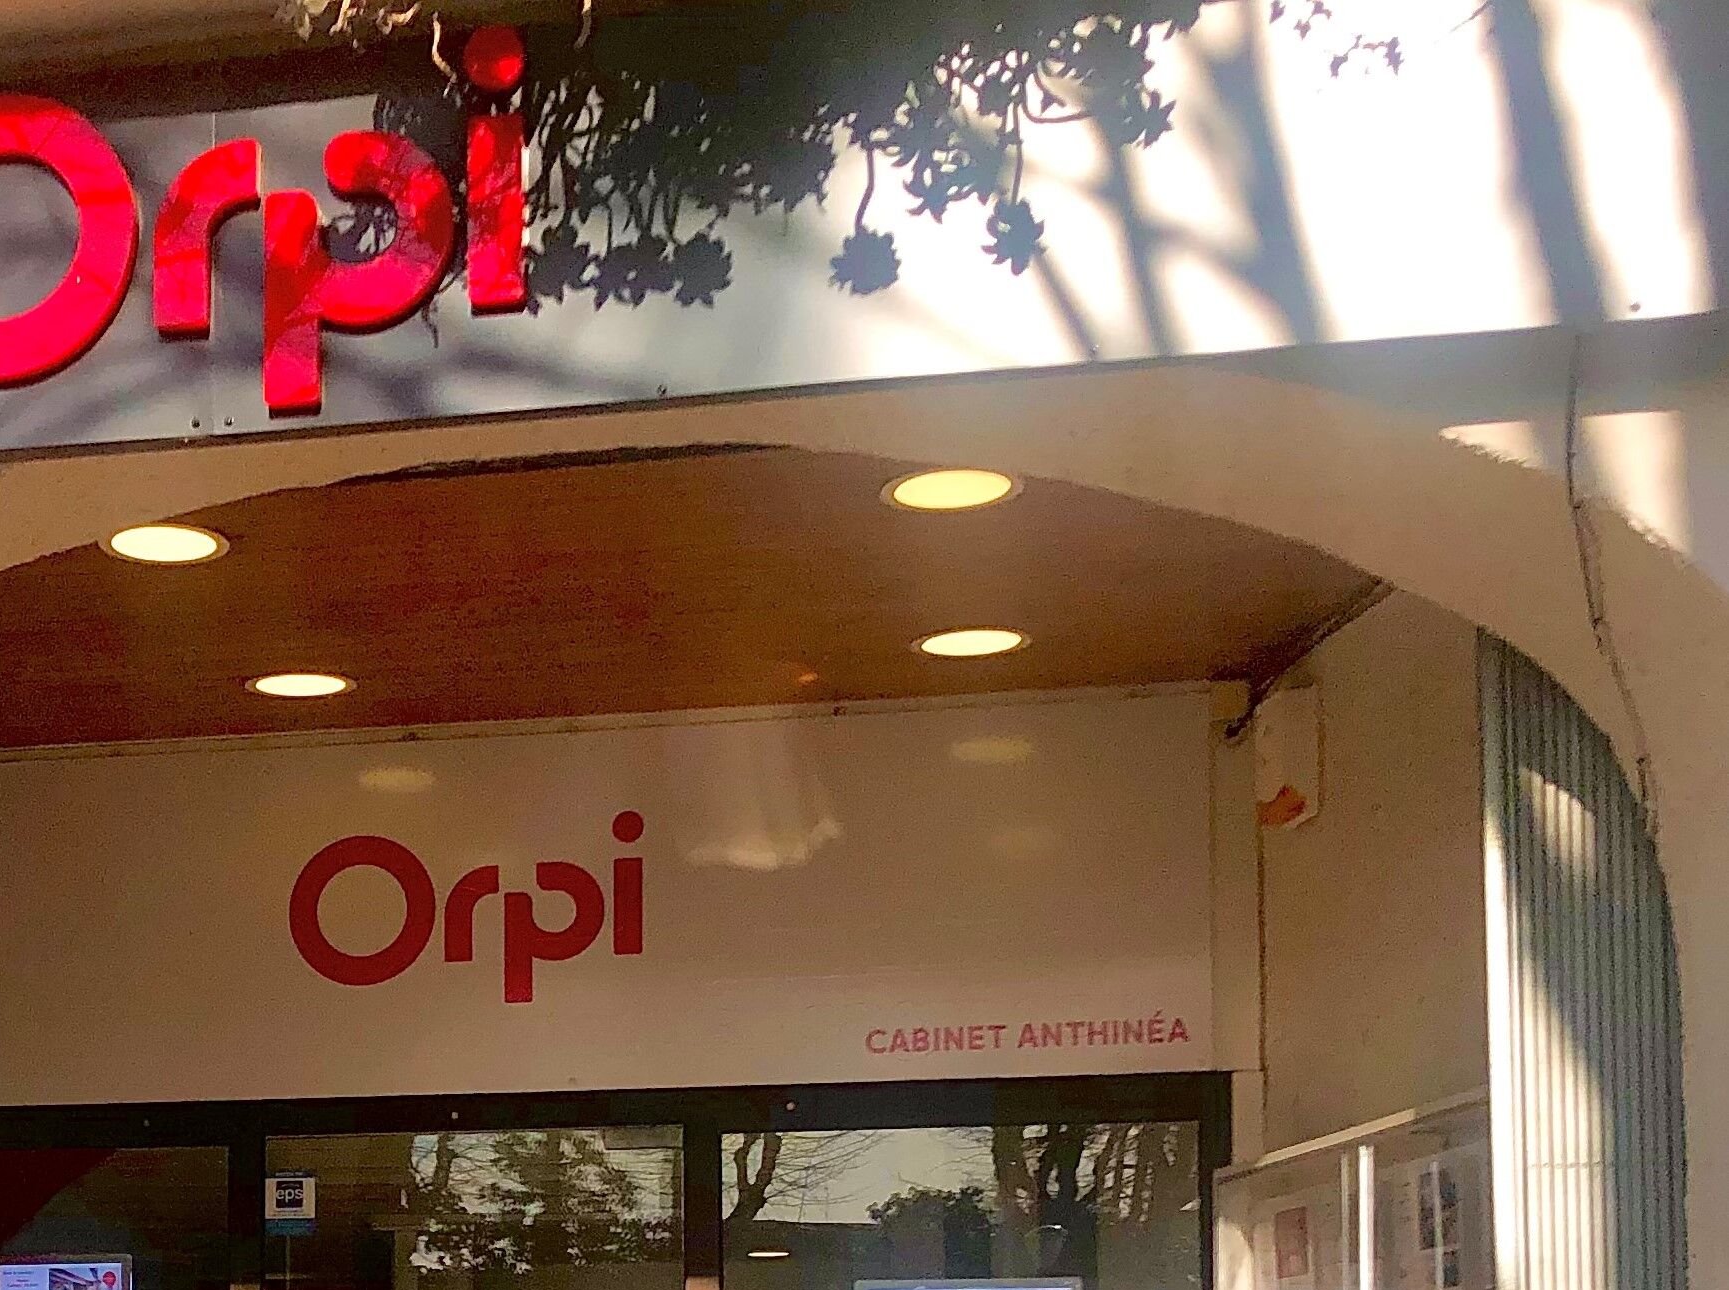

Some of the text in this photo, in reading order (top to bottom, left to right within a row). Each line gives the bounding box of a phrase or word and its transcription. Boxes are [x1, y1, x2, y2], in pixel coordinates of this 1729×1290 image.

[288, 810, 645, 1004] Orpi
[865, 1009, 1190, 1056] CABINET ANTHINÉA
[276, 1186, 304, 1204] eps
